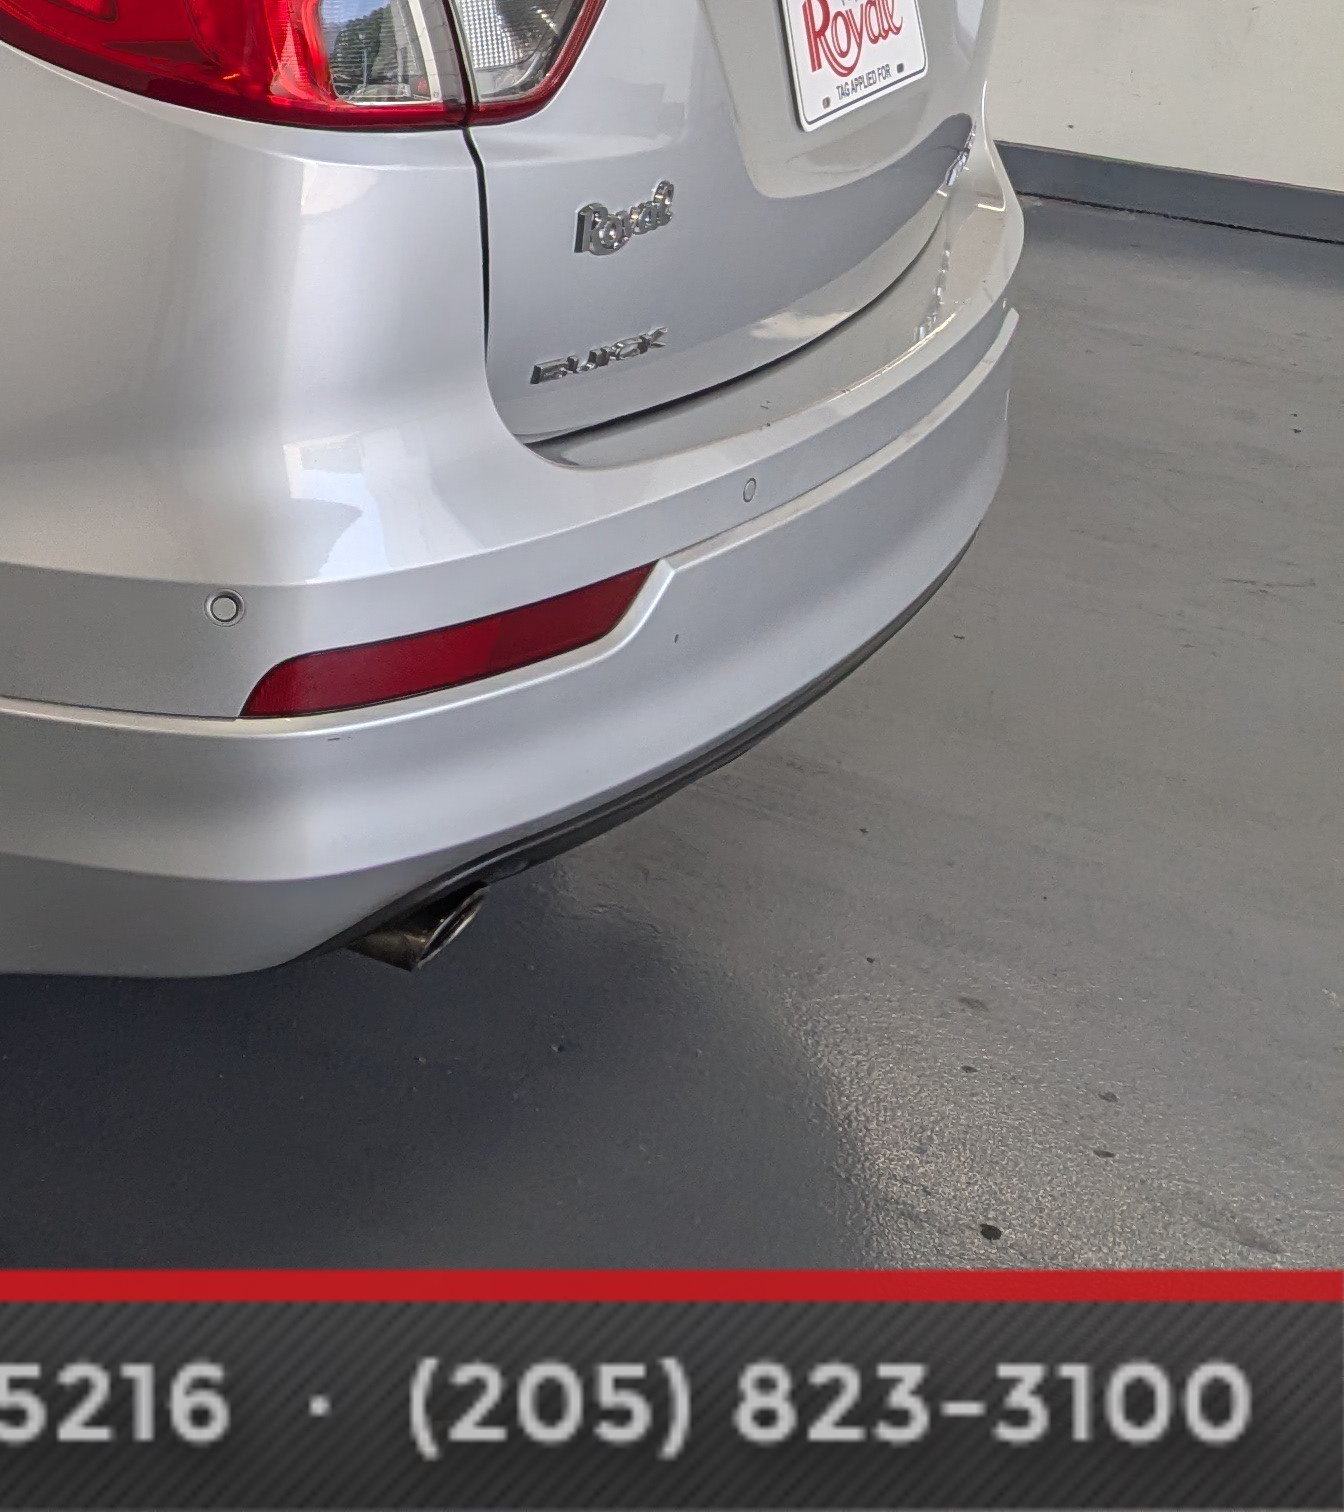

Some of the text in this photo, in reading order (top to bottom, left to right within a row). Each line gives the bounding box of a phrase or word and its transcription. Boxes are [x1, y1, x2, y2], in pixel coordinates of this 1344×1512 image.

[835, 63, 892, 100] TAG APPLIED FOR
